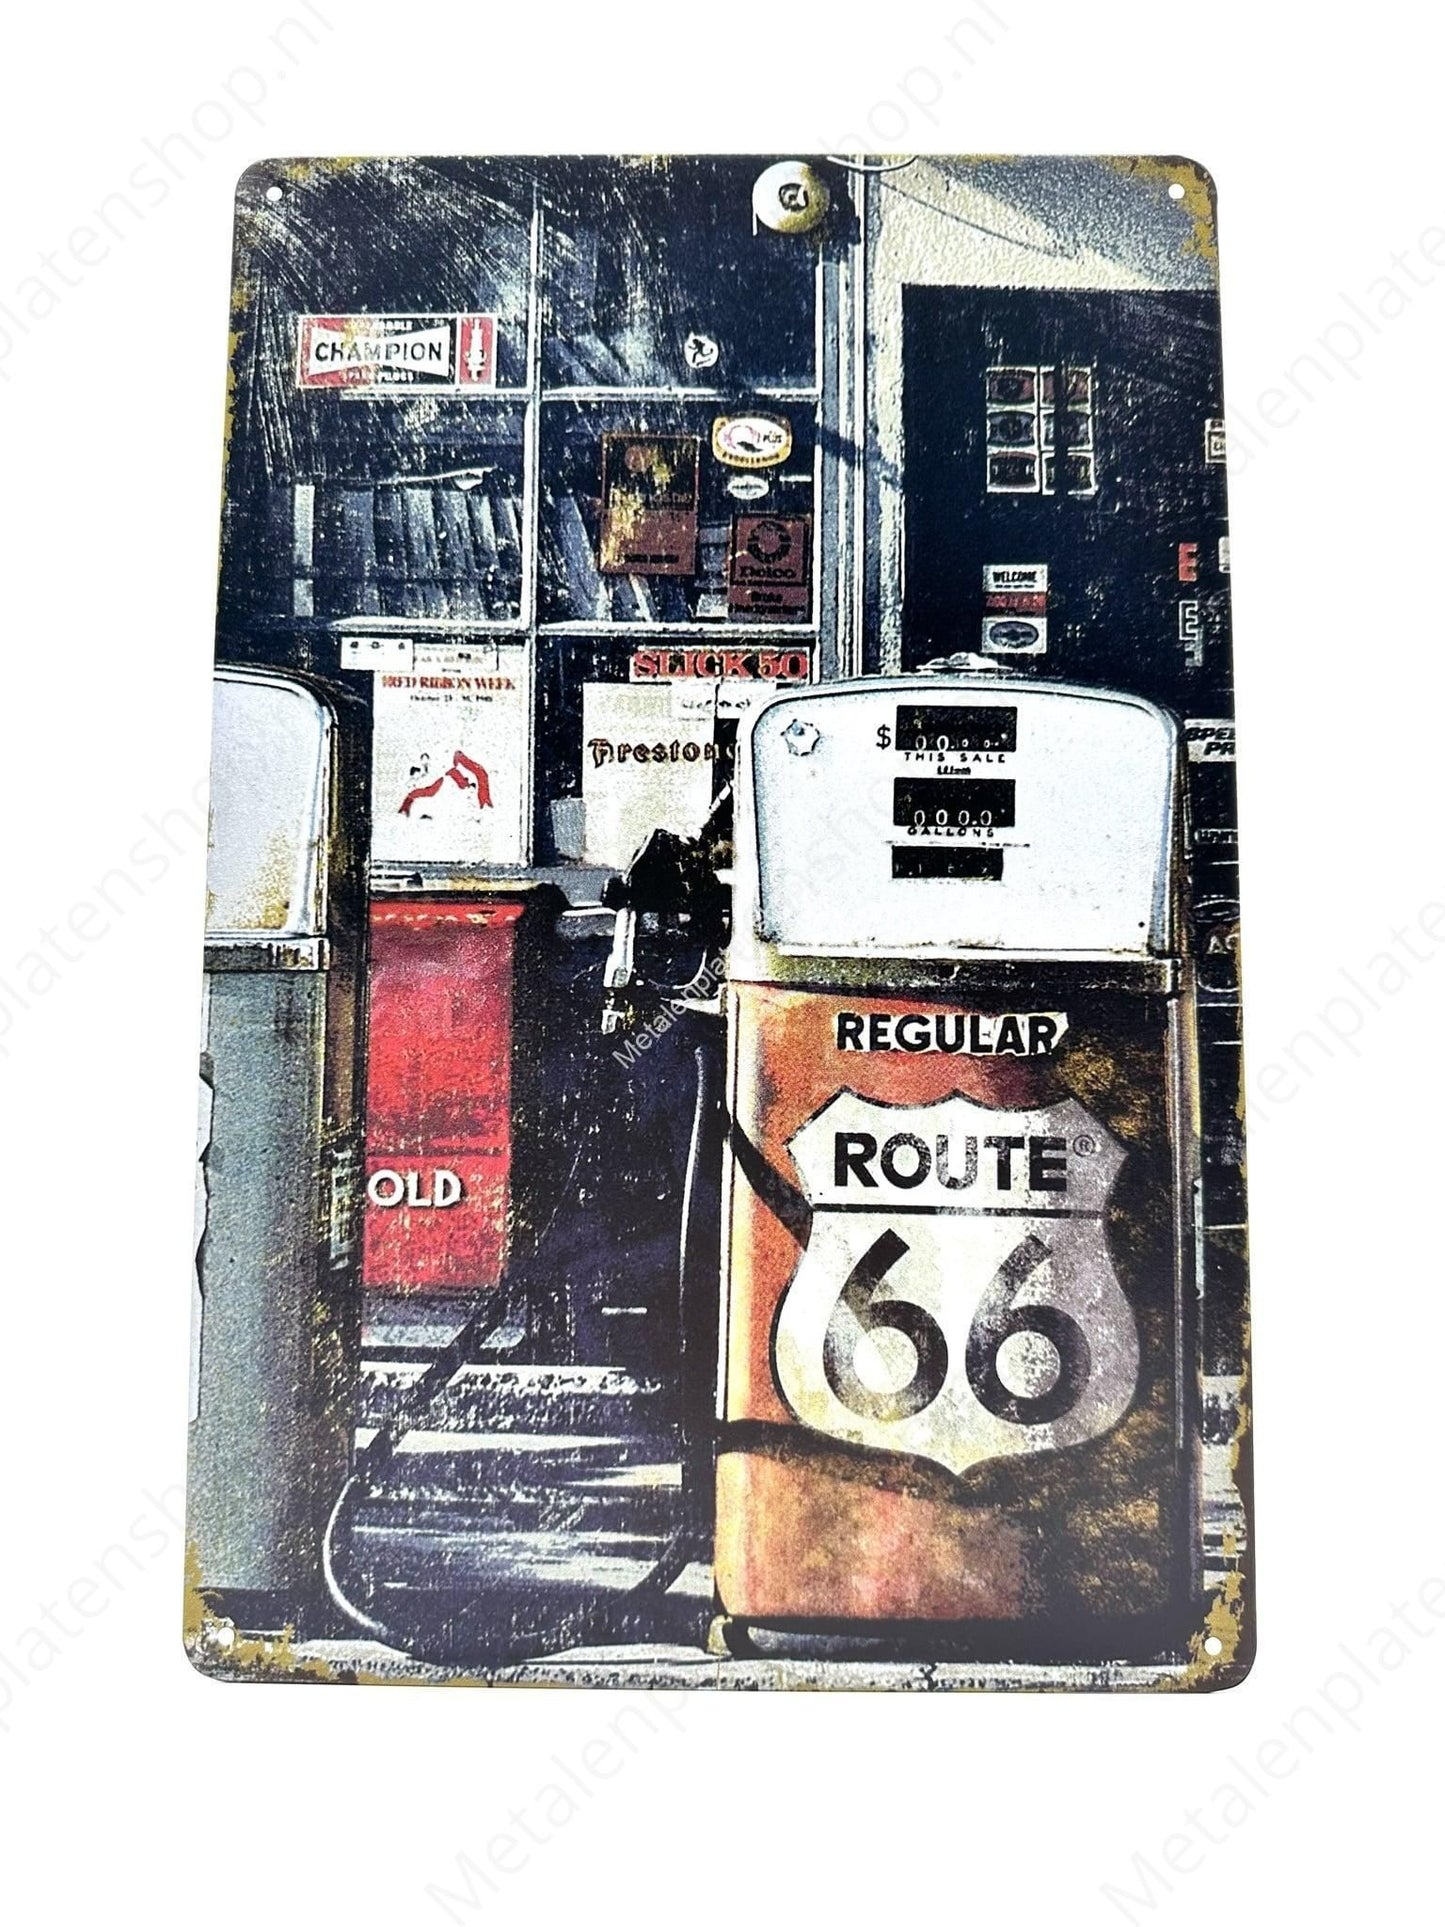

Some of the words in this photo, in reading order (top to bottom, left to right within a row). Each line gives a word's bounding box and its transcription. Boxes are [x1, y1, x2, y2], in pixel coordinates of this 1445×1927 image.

[314, 342, 443, 362] CHAMPION
[992, 571, 1038, 583] WELCOME
[633, 651, 751, 678] SLICK
[758, 651, 809, 679] 50
[420, 676, 471, 690] RIBBON
[475, 677, 516, 691] WEEK
[875, 723, 892, 751] $
[904, 752, 946, 762] THIS
[960, 752, 1007, 763] SALE
[907, 827, 994, 838] GALLONS
[836, 1012, 1058, 1054] REGULAR
[834, 1132, 1067, 1191] ROUTE
[367, 1169, 463, 1208] OLD
[823, 1228, 1091, 1425] 66
